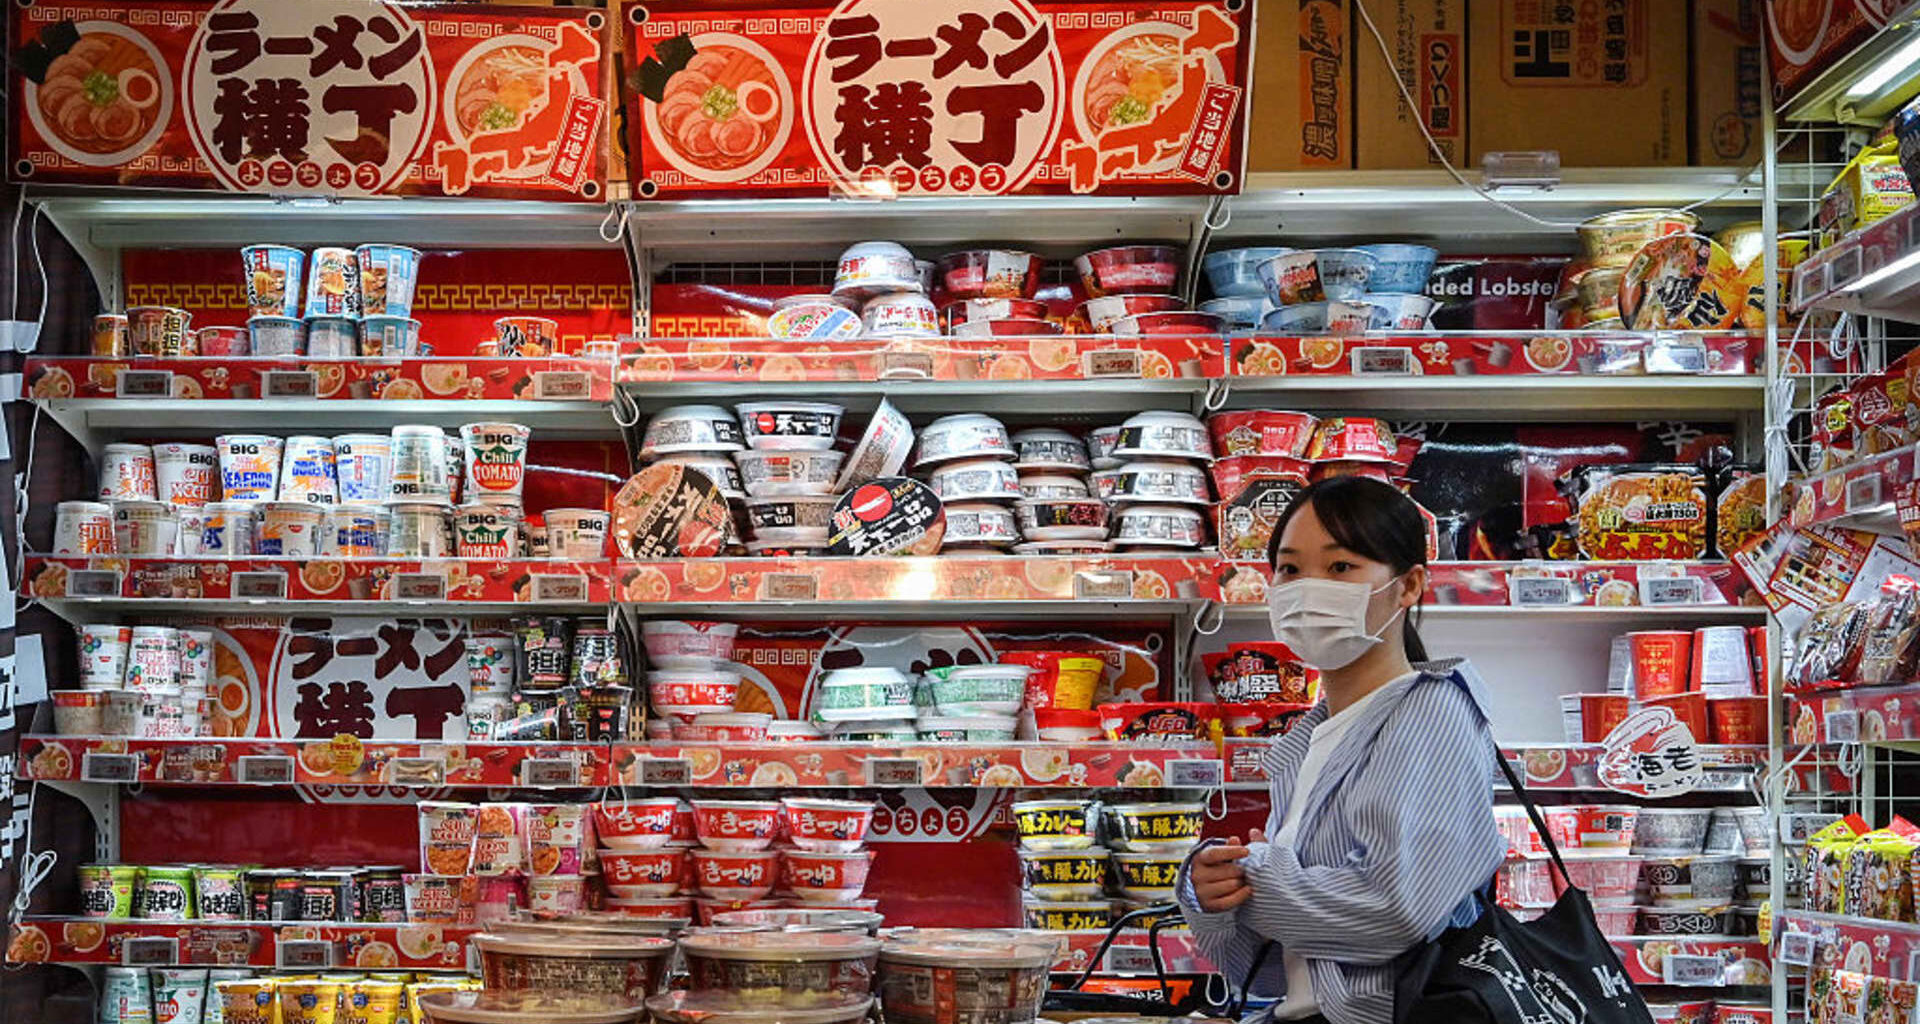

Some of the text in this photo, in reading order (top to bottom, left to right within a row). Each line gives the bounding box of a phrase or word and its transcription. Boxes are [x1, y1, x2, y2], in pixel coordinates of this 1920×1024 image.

[206, 11, 423, 80] ラーメン
[825, 12, 1050, 82] ラーメン
[1430, 41, 1450, 130] 麺づくり
[1302, 57, 1337, 160] 濃厚味噌
[212, 77, 418, 168] 横丁
[833, 81, 1045, 172] 横丁
[1188, 92, 1229, 170] ご当地麺
[239, 162, 379, 187] よこちょう
[162, 315, 182, 356] 担担
[230, 444, 258, 455] BIG
[485, 435, 512, 445] BIG
[189, 453, 213, 465] BIG
[481, 452, 514, 464] Chili
[475, 464, 521, 481] TOMATO
[468, 515, 496, 525] BIG
[578, 519, 603, 531] BIG
[466, 531, 497, 544] Chili
[289, 618, 466, 681] ラーメン
[1636, 746, 1697, 779] 海老
[1646, 776, 1698, 792] ラーメン
[872, 809, 967, 834] こちょう
[1017, 812, 1084, 834] 豚カレー
